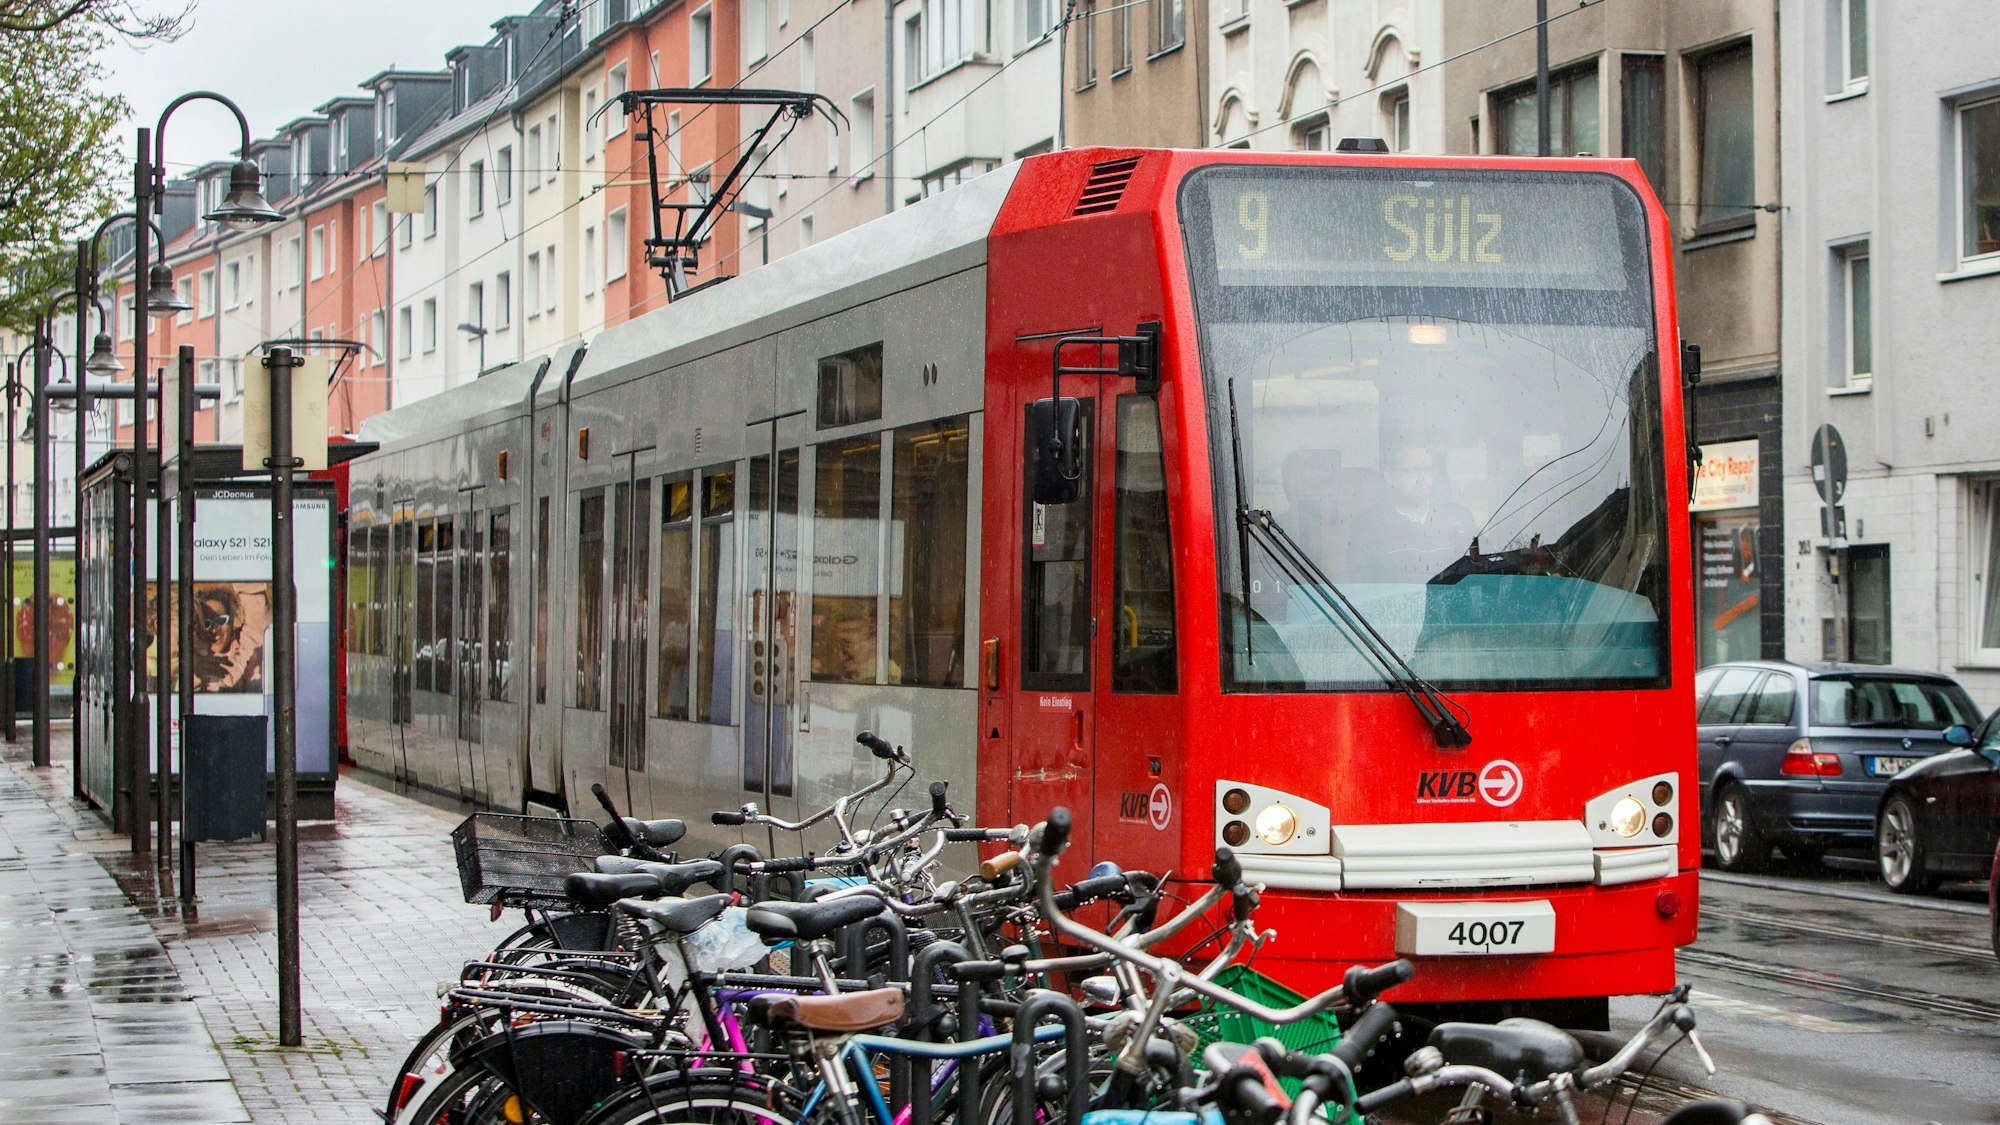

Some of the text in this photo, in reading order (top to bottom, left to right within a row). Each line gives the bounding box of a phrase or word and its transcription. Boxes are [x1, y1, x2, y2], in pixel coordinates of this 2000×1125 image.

[1238, 191, 1502, 262] 9 Sülz
[1708, 459, 1725, 480] City
[1728, 456, 1754, 478] Repair
[212, 490, 255, 498] JCDecaux
[194, 537, 272, 550] alaxy S21 S21
[1252, 580, 1280, 593] 0 1
[1040, 696, 1072, 709] Kein Einstieg
[1880, 758, 1888, 771] K
[1417, 771, 1477, 797] KVB
[1120, 792, 1150, 818] KVB
[1448, 921, 1524, 945] 4007
[1485, 943, 1489, 953] 1
